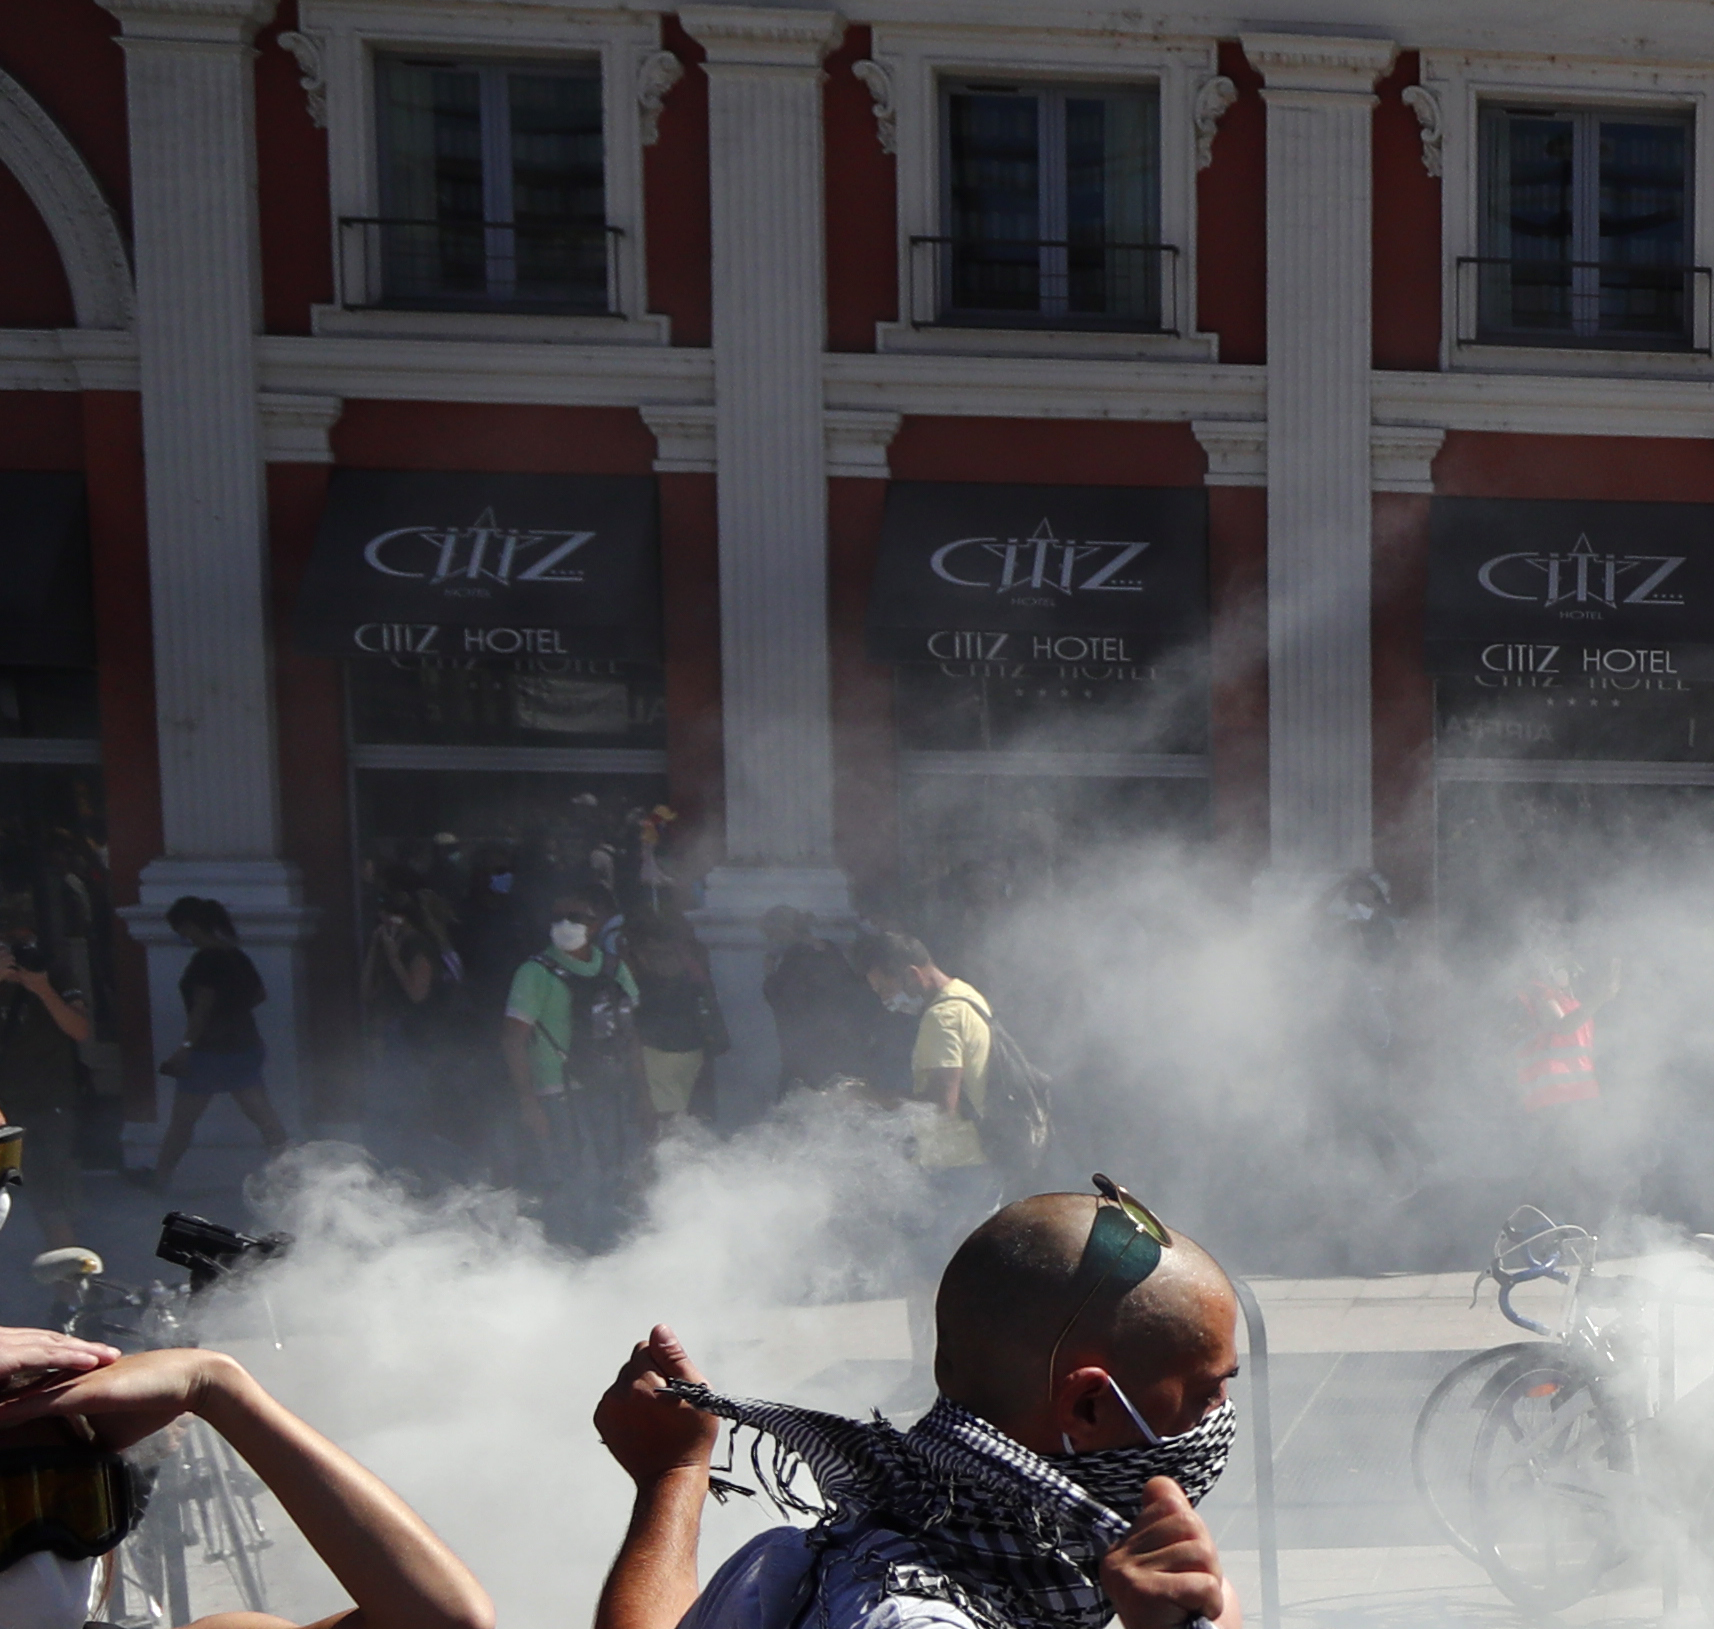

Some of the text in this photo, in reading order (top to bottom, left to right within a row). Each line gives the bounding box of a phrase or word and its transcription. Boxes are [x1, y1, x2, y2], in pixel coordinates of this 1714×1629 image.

[1558, 610, 1604, 620] HOTEL
[464, 627, 568, 654] HOTEL
[1032, 635, 1132, 662] HOTEL
[1582, 647, 1678, 674] HOTEL
